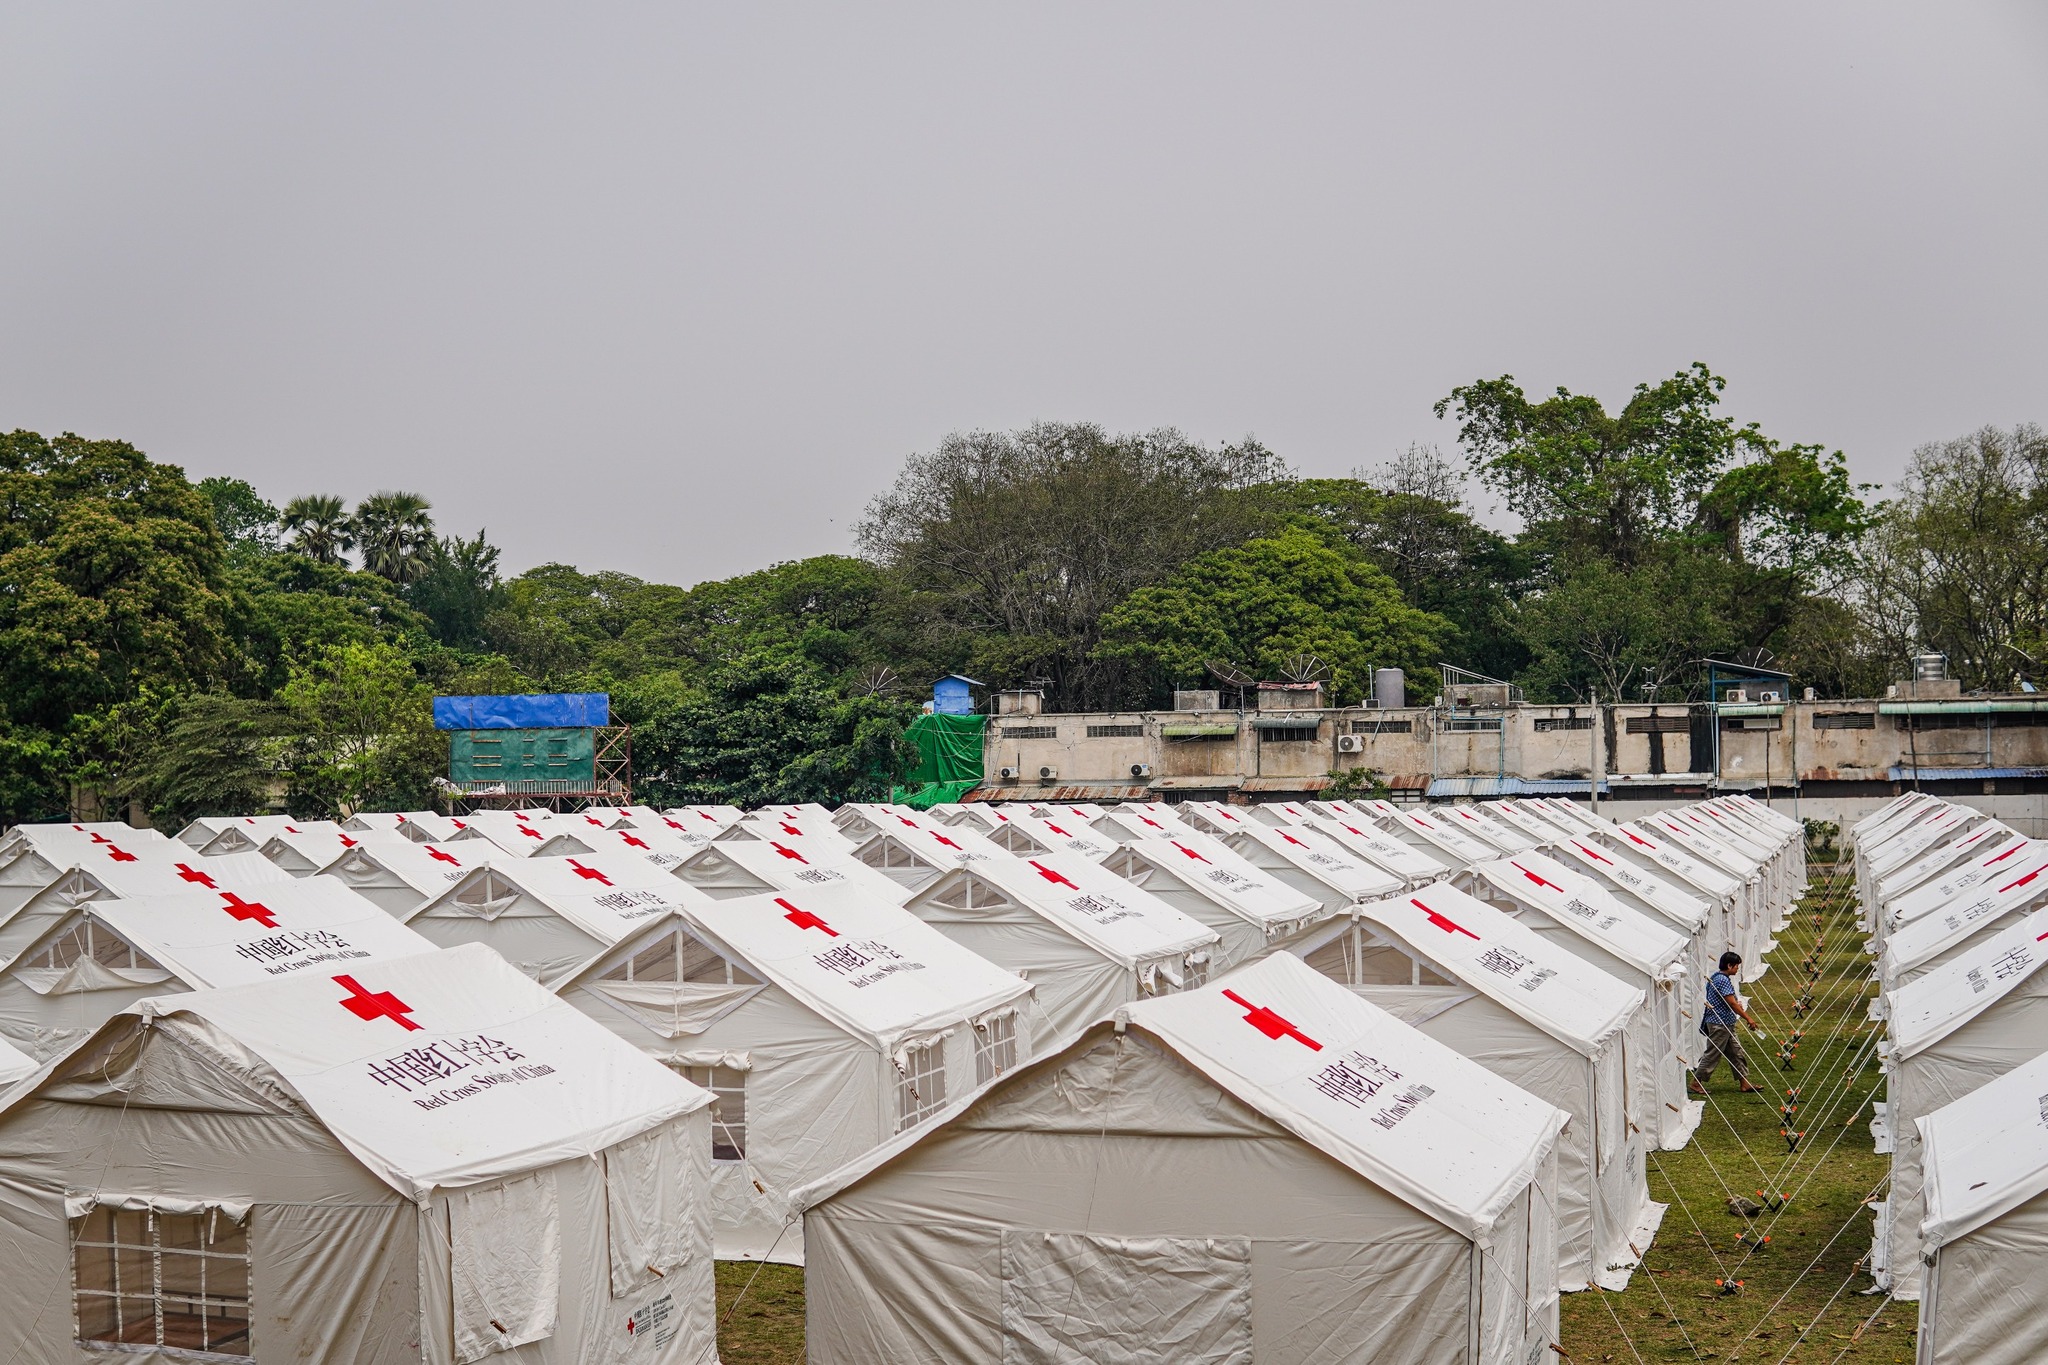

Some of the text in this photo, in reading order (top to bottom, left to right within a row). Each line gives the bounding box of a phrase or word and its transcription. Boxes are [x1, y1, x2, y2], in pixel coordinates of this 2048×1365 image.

[236, 930, 351, 963] 中国红十字会
[813, 940, 904, 975] 中国红十字会
[265, 964, 287, 975] Red
[284, 959, 313, 971] Cross
[367, 1035, 526, 1092] 中国红十字会
[1308, 1050, 1404, 1109] 中国红十字会
[413, 1095, 448, 1110] Red
[440, 1084, 482, 1101] Cross
[471, 1071, 520, 1089] Society
[518, 1064, 556, 1078] China
[1371, 1113, 1396, 1130] Red
[1380, 1103, 1411, 1121] Cross
